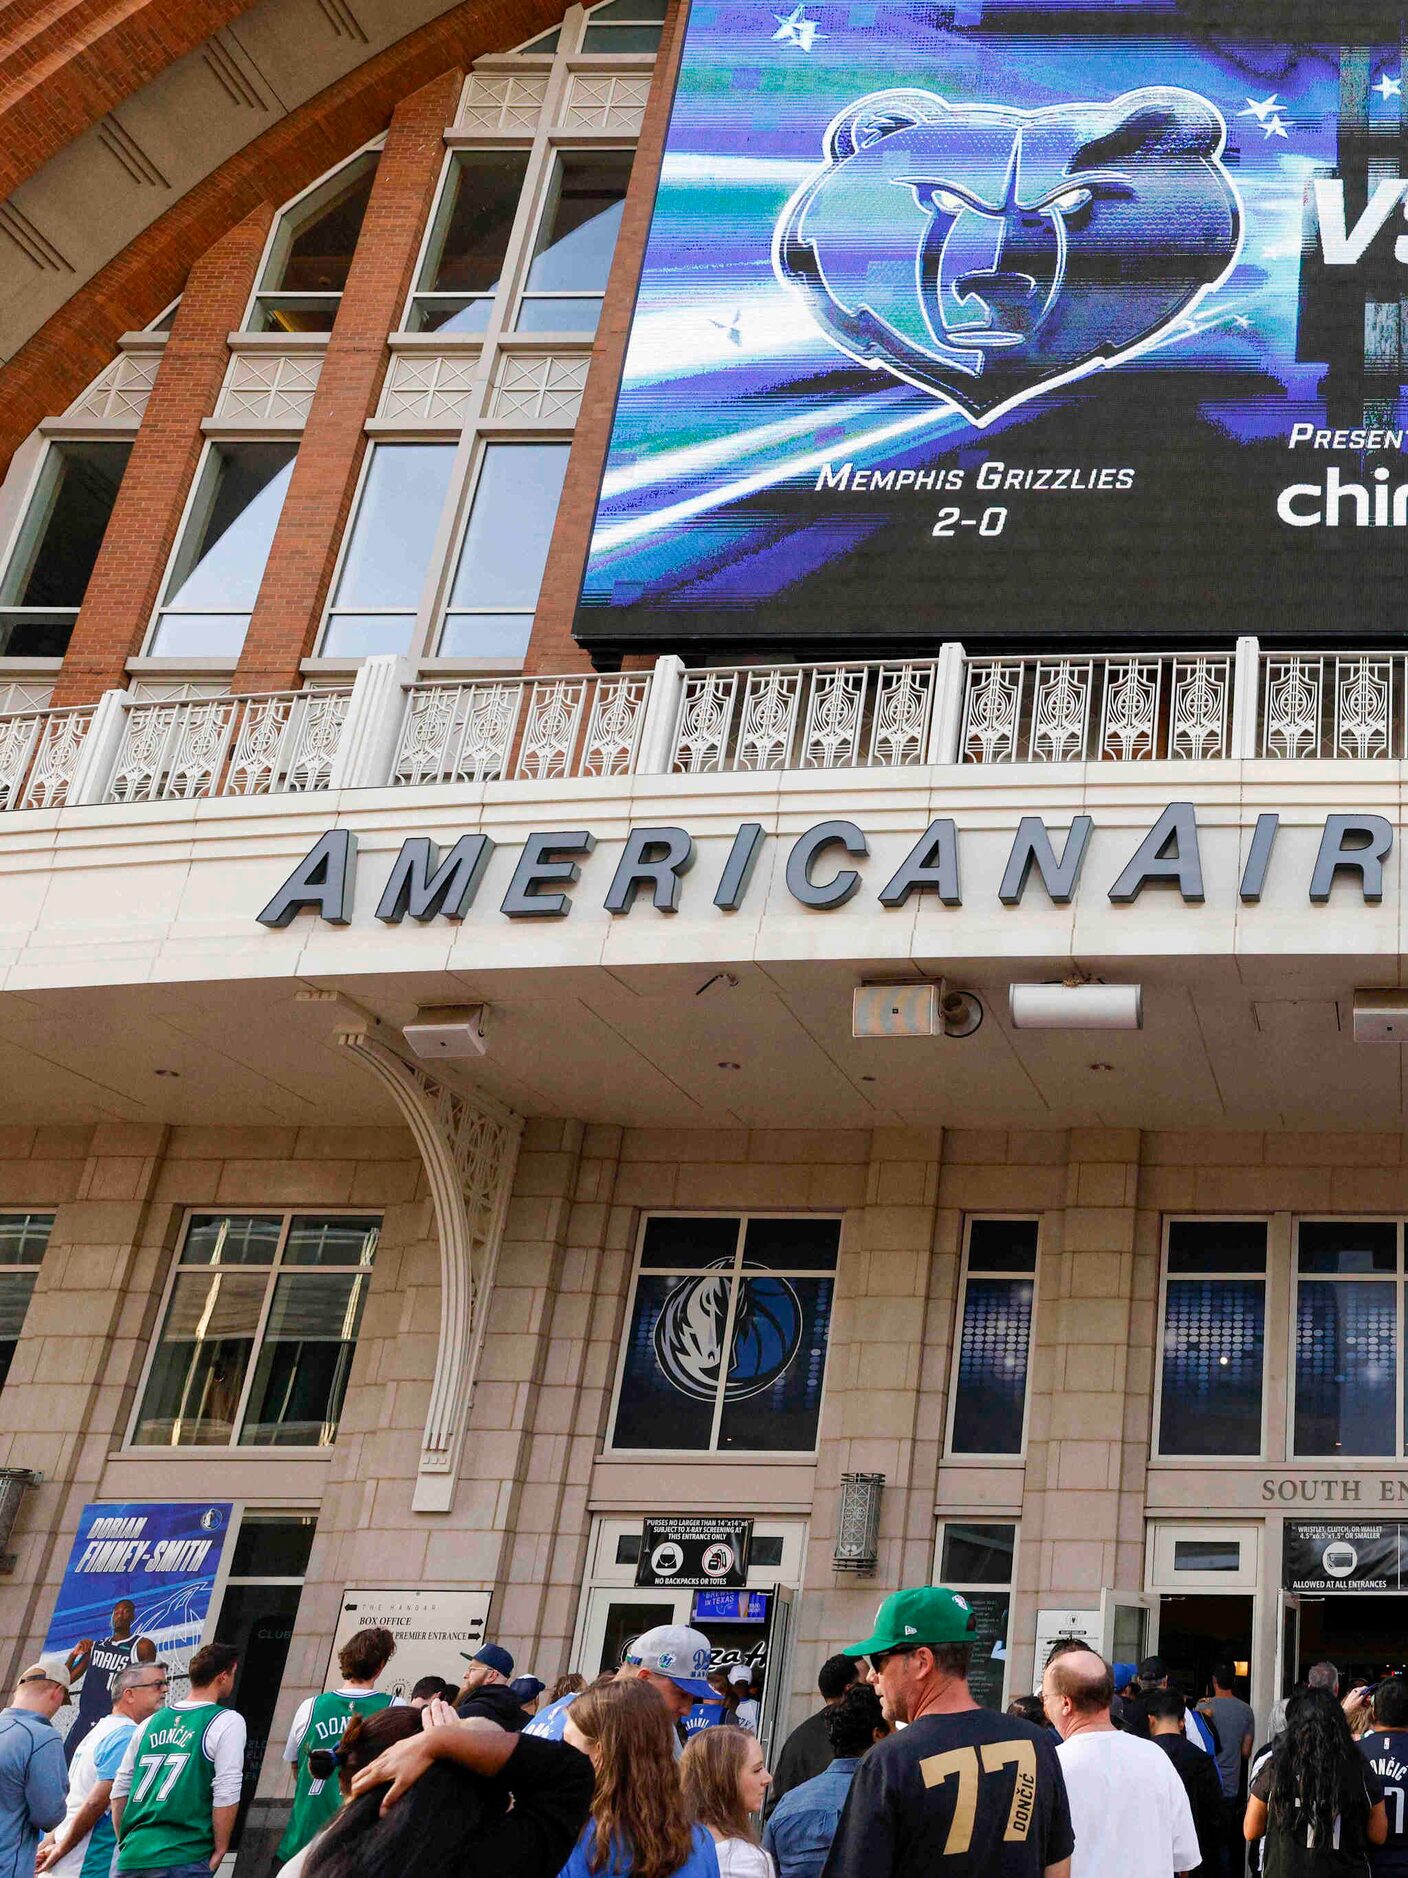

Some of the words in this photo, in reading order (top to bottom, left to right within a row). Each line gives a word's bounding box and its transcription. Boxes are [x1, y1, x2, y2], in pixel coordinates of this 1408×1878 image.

[814, 462, 965, 491] MEMPHIS
[975, 462, 1136, 490] GRIZZLIES
[931, 507, 1009, 537] 2-0
[255, 815, 1096, 928] AMERICAN
[1262, 1479, 1361, 1501] SOUTH
[87, 1517, 148, 1539] DORIAN
[74, 1540, 213, 1573] FINNEY-SMITH
[1293, 1580, 1325, 1588] ALLOWED
[1326, 1580, 1335, 1588] AT
[1335, 1580, 1347, 1588] ALL
[1348, 1580, 1387, 1588] ENTRANCES
[712, 1595, 735, 1605] TEXAS
[359, 1617, 377, 1626] BOX
[379, 1617, 411, 1626] OFFICE
[395, 1632, 427, 1641] PREMIER
[428, 1632, 467, 1641] ENTRANCE
[92, 1649, 130, 1671] MAVS
[149, 1725, 195, 1748] DONČIĆ
[315, 1716, 352, 1740] DON
[133, 1753, 190, 1802] 77
[919, 1739, 1037, 1855] 77
[1013, 1773, 1034, 1832] DONČIĆ
[1384, 1786, 1405, 1834] 7
